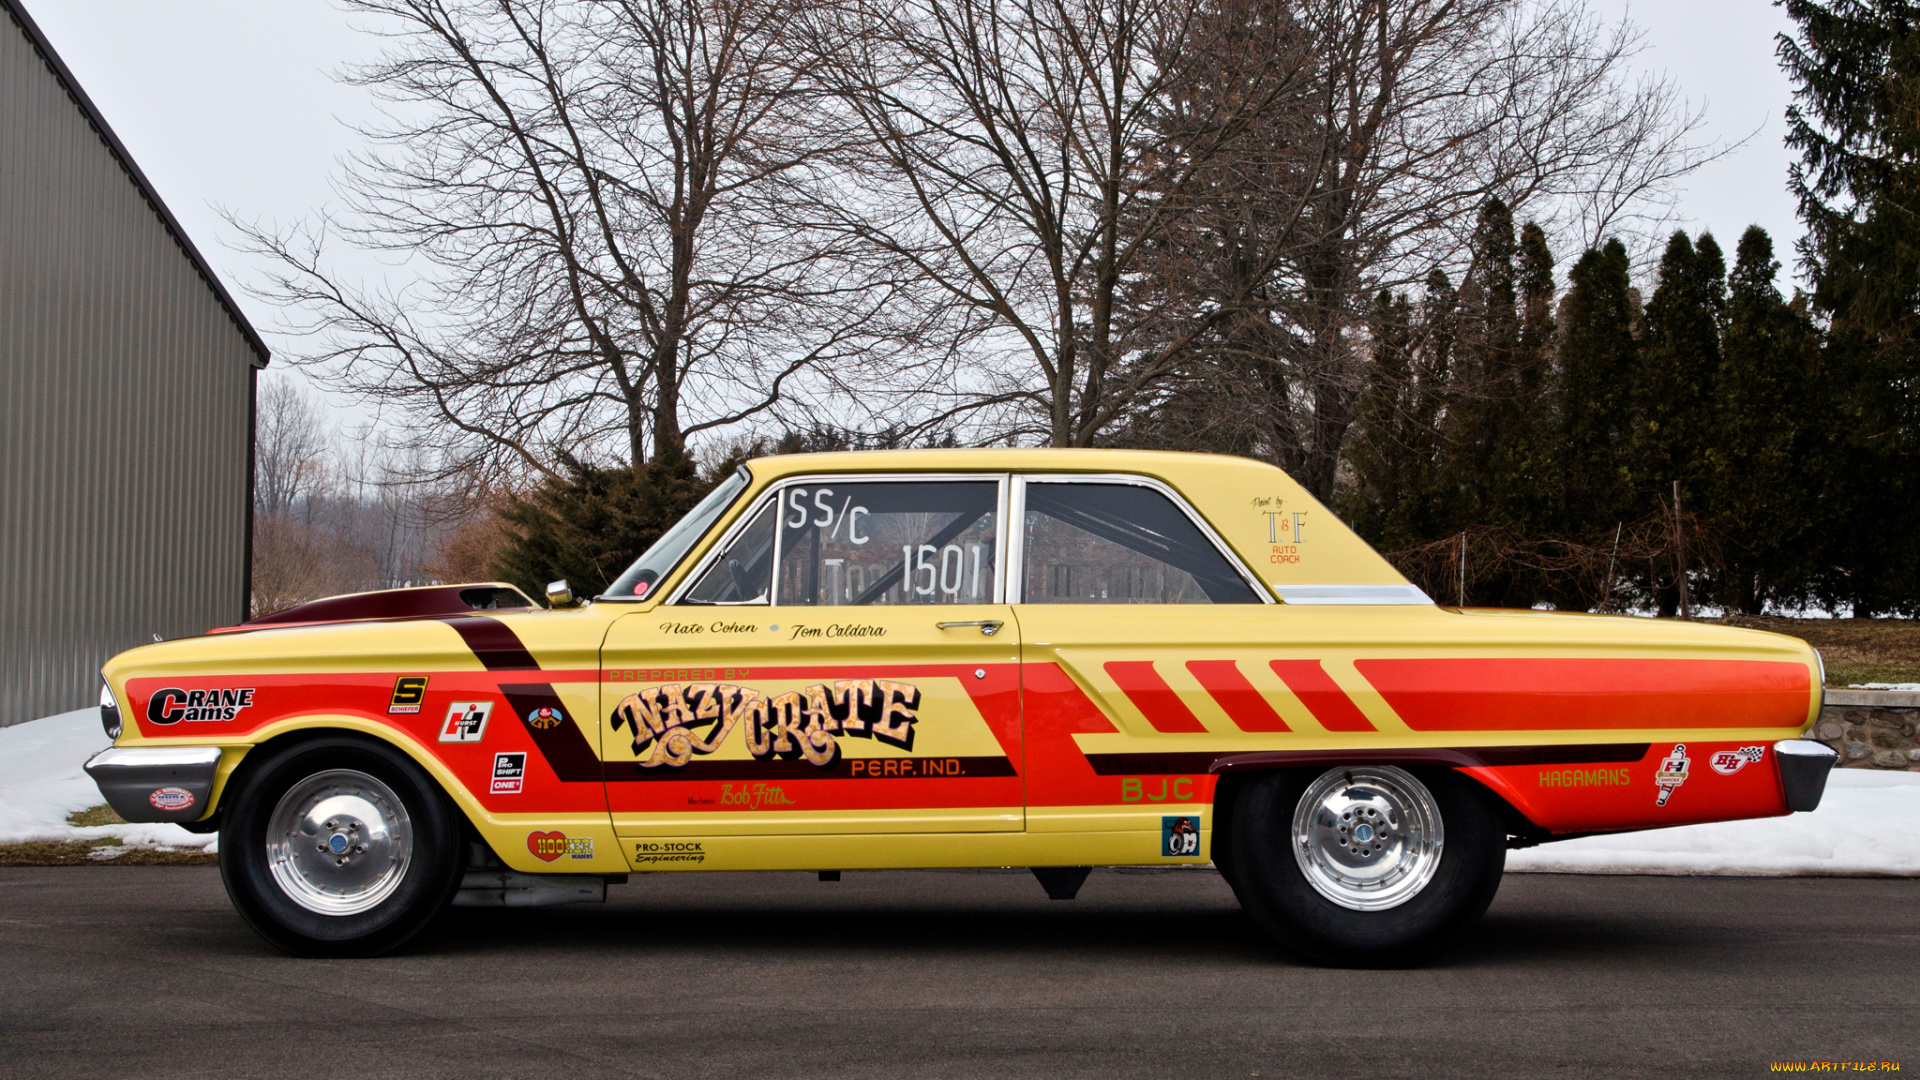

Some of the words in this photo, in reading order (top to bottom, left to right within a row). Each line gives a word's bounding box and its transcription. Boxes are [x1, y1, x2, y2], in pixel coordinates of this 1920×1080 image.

[1250, 496, 1271, 509] Paint
[1272, 545, 1297, 554] AUTO
[1270, 555, 1300, 564] COACH
[902, 544, 980, 598] 1501
[659, 621, 704, 635] Nate
[710, 621, 758, 634] Cohen
[788, 624, 823, 641] Tom
[826, 623, 887, 639] Caldara
[609, 669, 715, 681] PREPARED
[724, 668, 750, 679] BY
[147, 687, 256, 726] CRANE
[744, 679, 919, 769] CRATE
[498, 757, 513, 768] PRO
[851, 759, 917, 776] PERF.
[922, 759, 966, 775] IND.
[1539, 768, 1630, 788] HAGAMANS
[721, 784, 750, 805] Bob
[750, 783, 796, 810] Fitts
[537, 838, 593, 854] HOOKER
[636, 842, 702, 852] PRO-STOCK
[635, 852, 705, 864] Engineering
